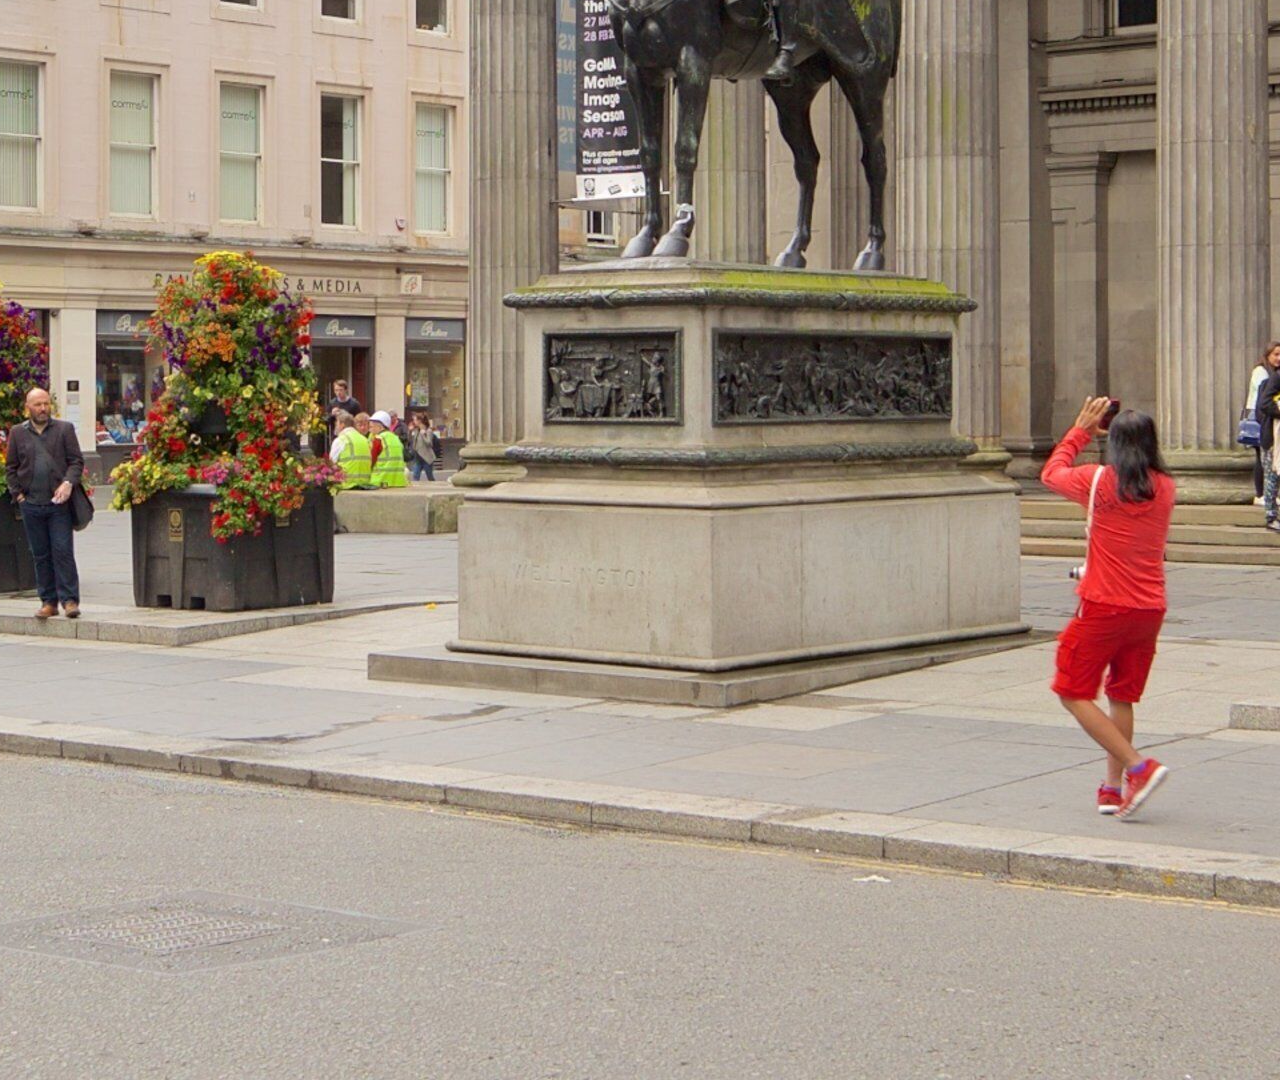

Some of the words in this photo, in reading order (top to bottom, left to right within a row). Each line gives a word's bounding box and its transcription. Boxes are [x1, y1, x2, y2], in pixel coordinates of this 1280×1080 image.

[583, 16, 597, 28] 27
[583, 56, 617, 72] GoMA
[583, 93, 621, 108] Image
[583, 109, 626, 123] Season
[582, 127, 604, 139] APR
[296, 277, 305, 292] &
[312, 278, 362, 294] MEDIA
